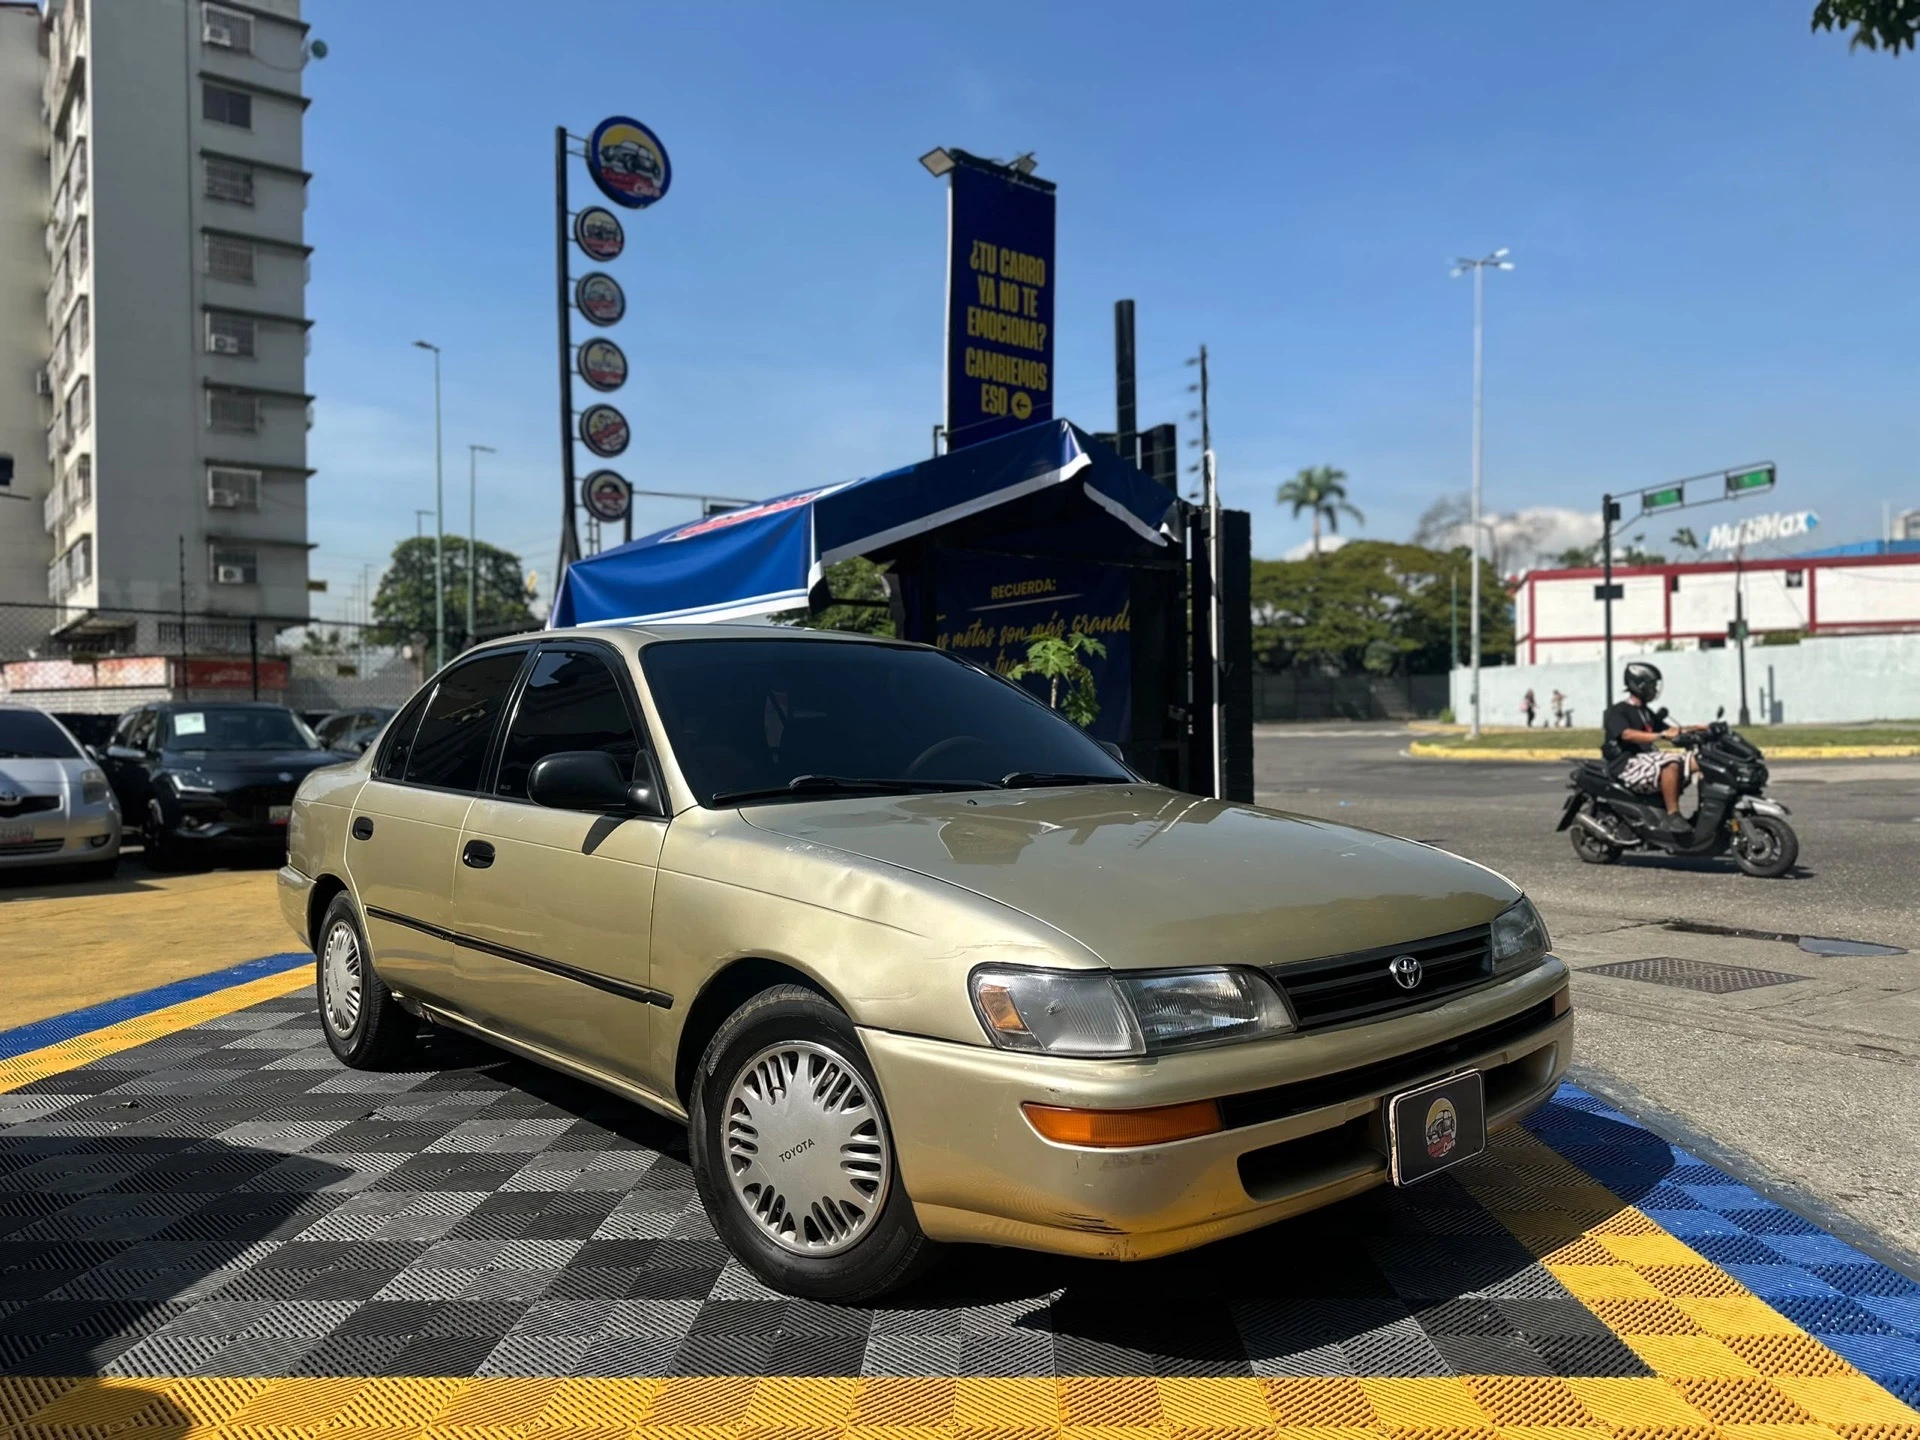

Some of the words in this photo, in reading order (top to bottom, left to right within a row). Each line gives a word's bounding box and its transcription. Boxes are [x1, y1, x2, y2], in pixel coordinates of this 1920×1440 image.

[970, 240, 997, 274] ¿TU
[1001, 248, 1045, 287] CARRO
[978, 275, 996, 307] YA
[999, 284, 1018, 313] NO
[1022, 287, 1038, 318] TE
[967, 306, 1047, 351] EMOCIONA?
[965, 347, 1047, 391] CAMBIEMOS
[981, 384, 1007, 416] ESO
[991, 578, 1057, 599] RECUERDA:
[952, 618, 996, 648] metas
[999, 624, 1026, 646] son
[779, 1138, 815, 1162] TOYOTA
